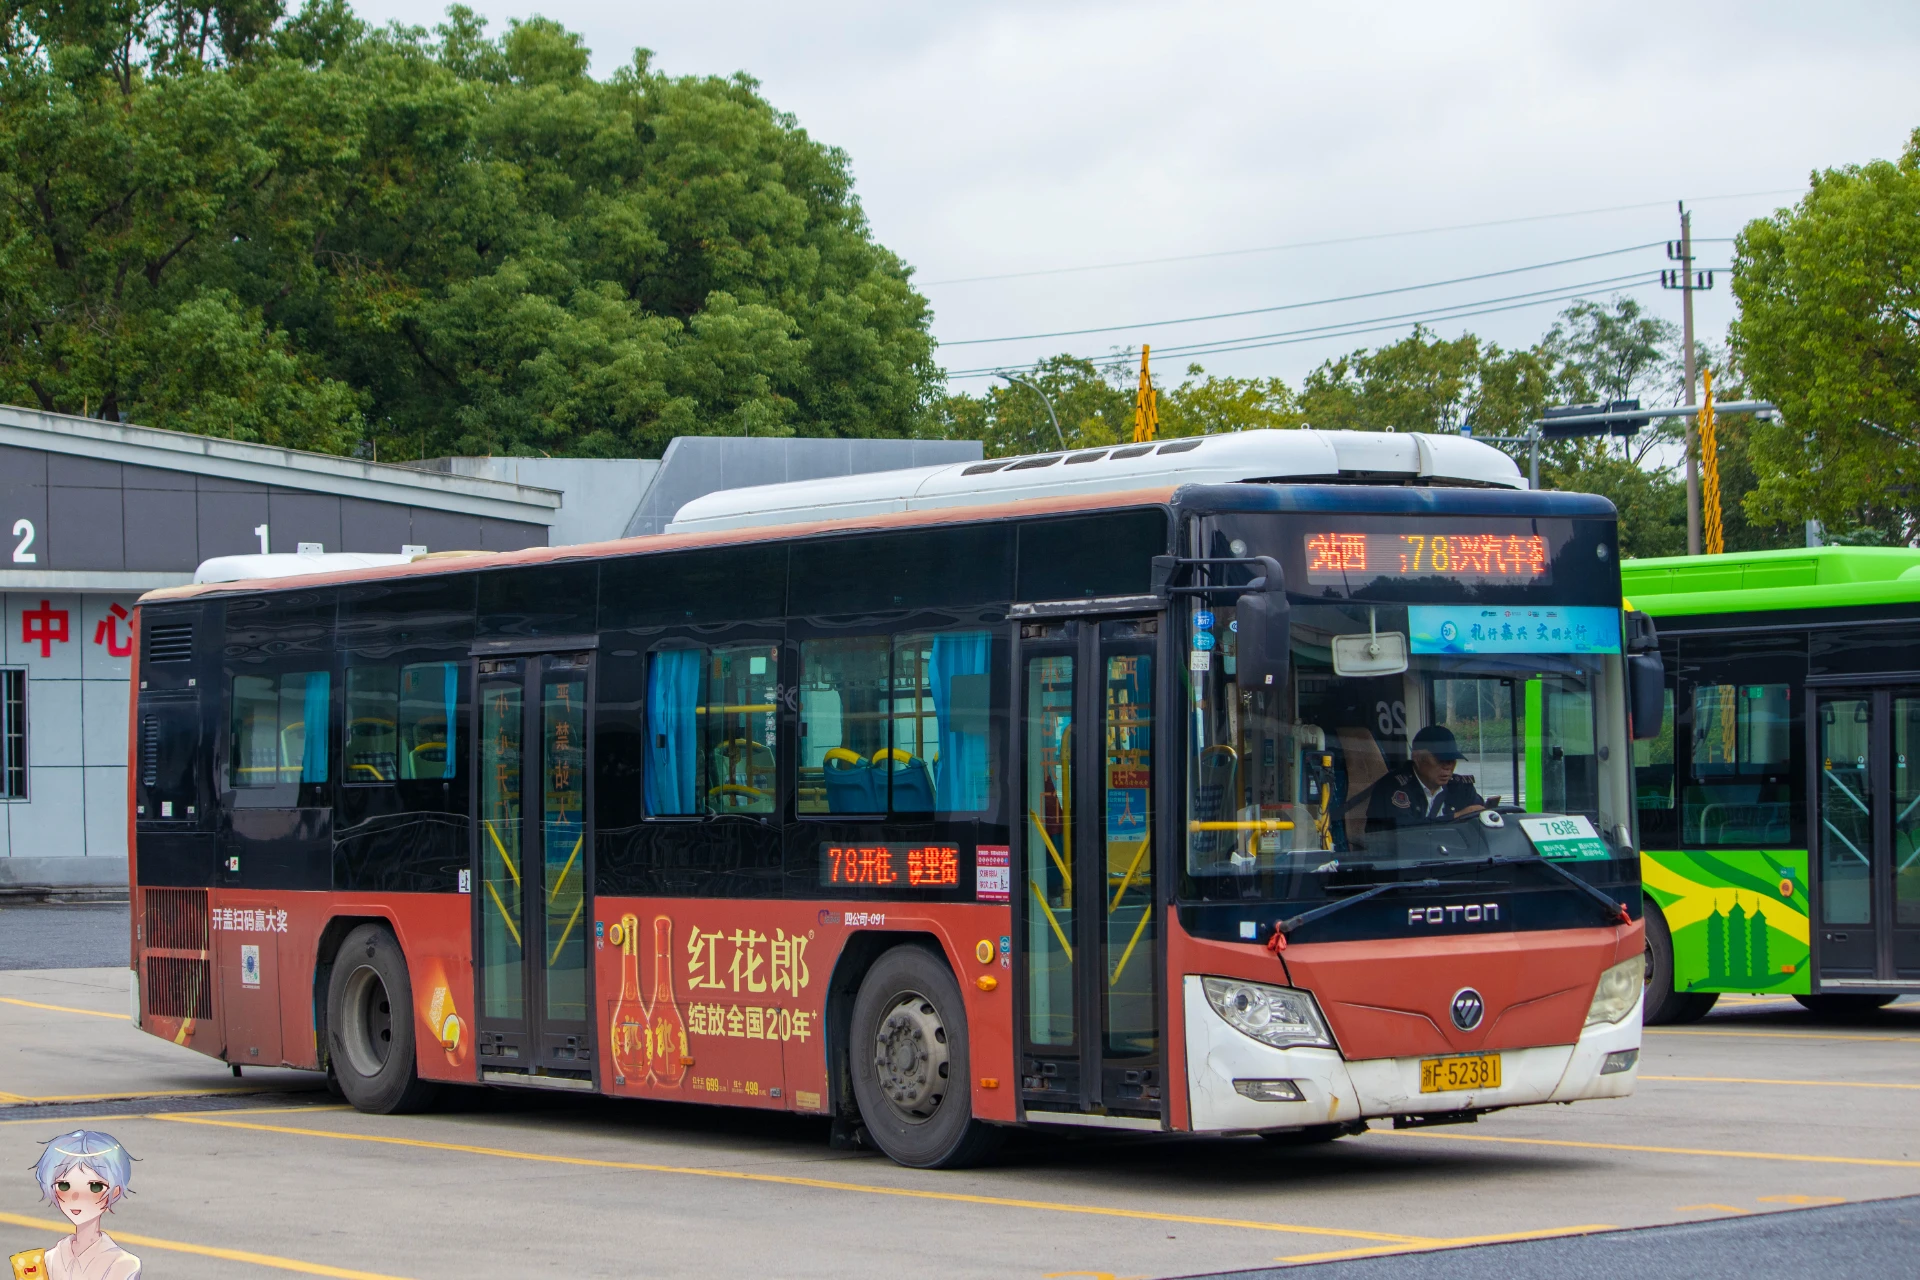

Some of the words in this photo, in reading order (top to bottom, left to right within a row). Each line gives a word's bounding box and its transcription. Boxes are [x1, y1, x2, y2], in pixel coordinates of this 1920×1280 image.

[13, 519, 36, 562] 2
[255, 524, 269, 554] 1
[1408, 536, 1449, 571] 78
[22, 600, 133, 657] 中心
[1471, 623, 1528, 642] 礼行嘉兴
[1536, 623, 1587, 642] 文明出行
[1539, 820, 1580, 836] 78路
[212, 908, 288, 933] 开盖扫码赢大奖
[844, 912, 885, 926] 四公司-091
[1408, 903, 1499, 926] FOTON
[687, 925, 810, 998] 红花郎
[706, 1077, 719, 1092] 699
[745, 1081, 759, 1095] 499
